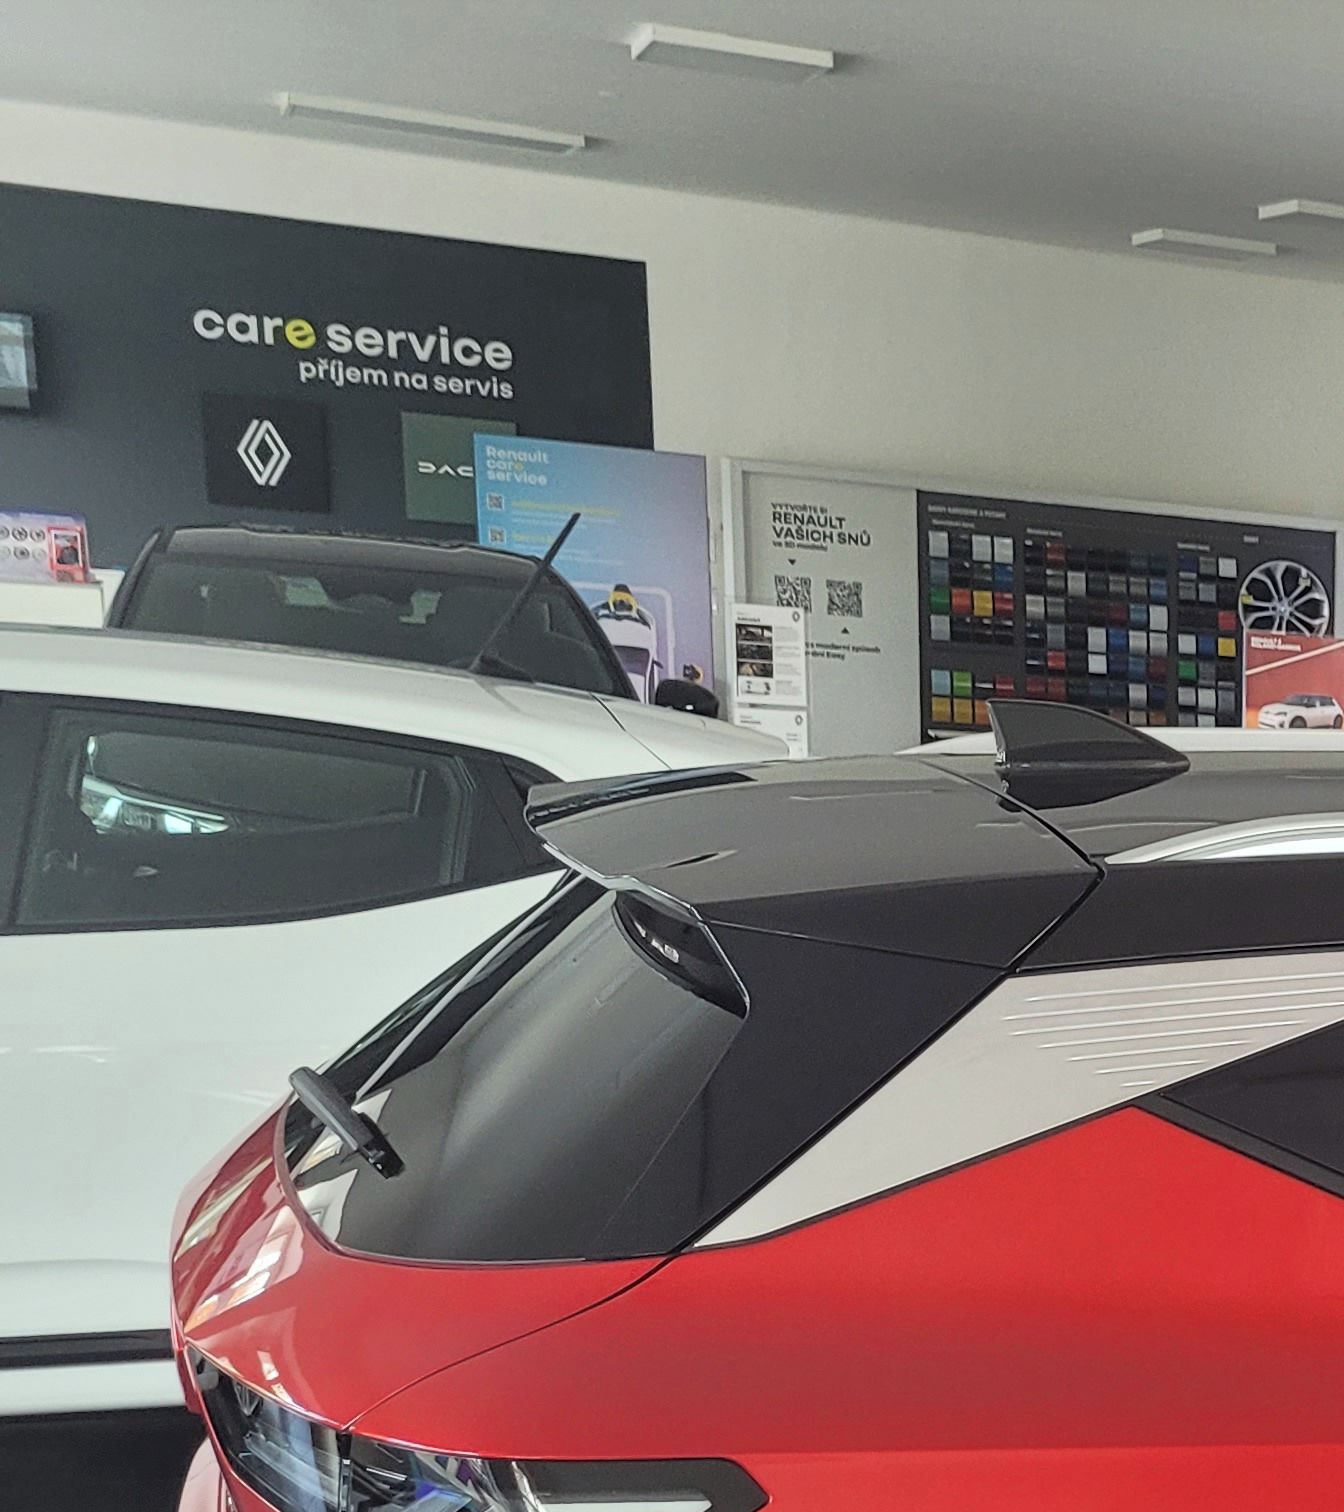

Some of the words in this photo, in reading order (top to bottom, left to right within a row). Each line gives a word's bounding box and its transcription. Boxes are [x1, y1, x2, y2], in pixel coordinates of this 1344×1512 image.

[193, 308, 317, 350] care
[326, 322, 513, 371] service
[299, 357, 388, 387] příjem
[394, 369, 428, 392] na
[433, 374, 514, 400] servis
[485, 445, 550, 465] Renault
[418, 461, 475, 478] DAC
[486, 469, 547, 486] service
[772, 511, 846, 529] RENAULT
[772, 525, 834, 544] VAŠICH
[837, 529, 871, 547] SNŮ
